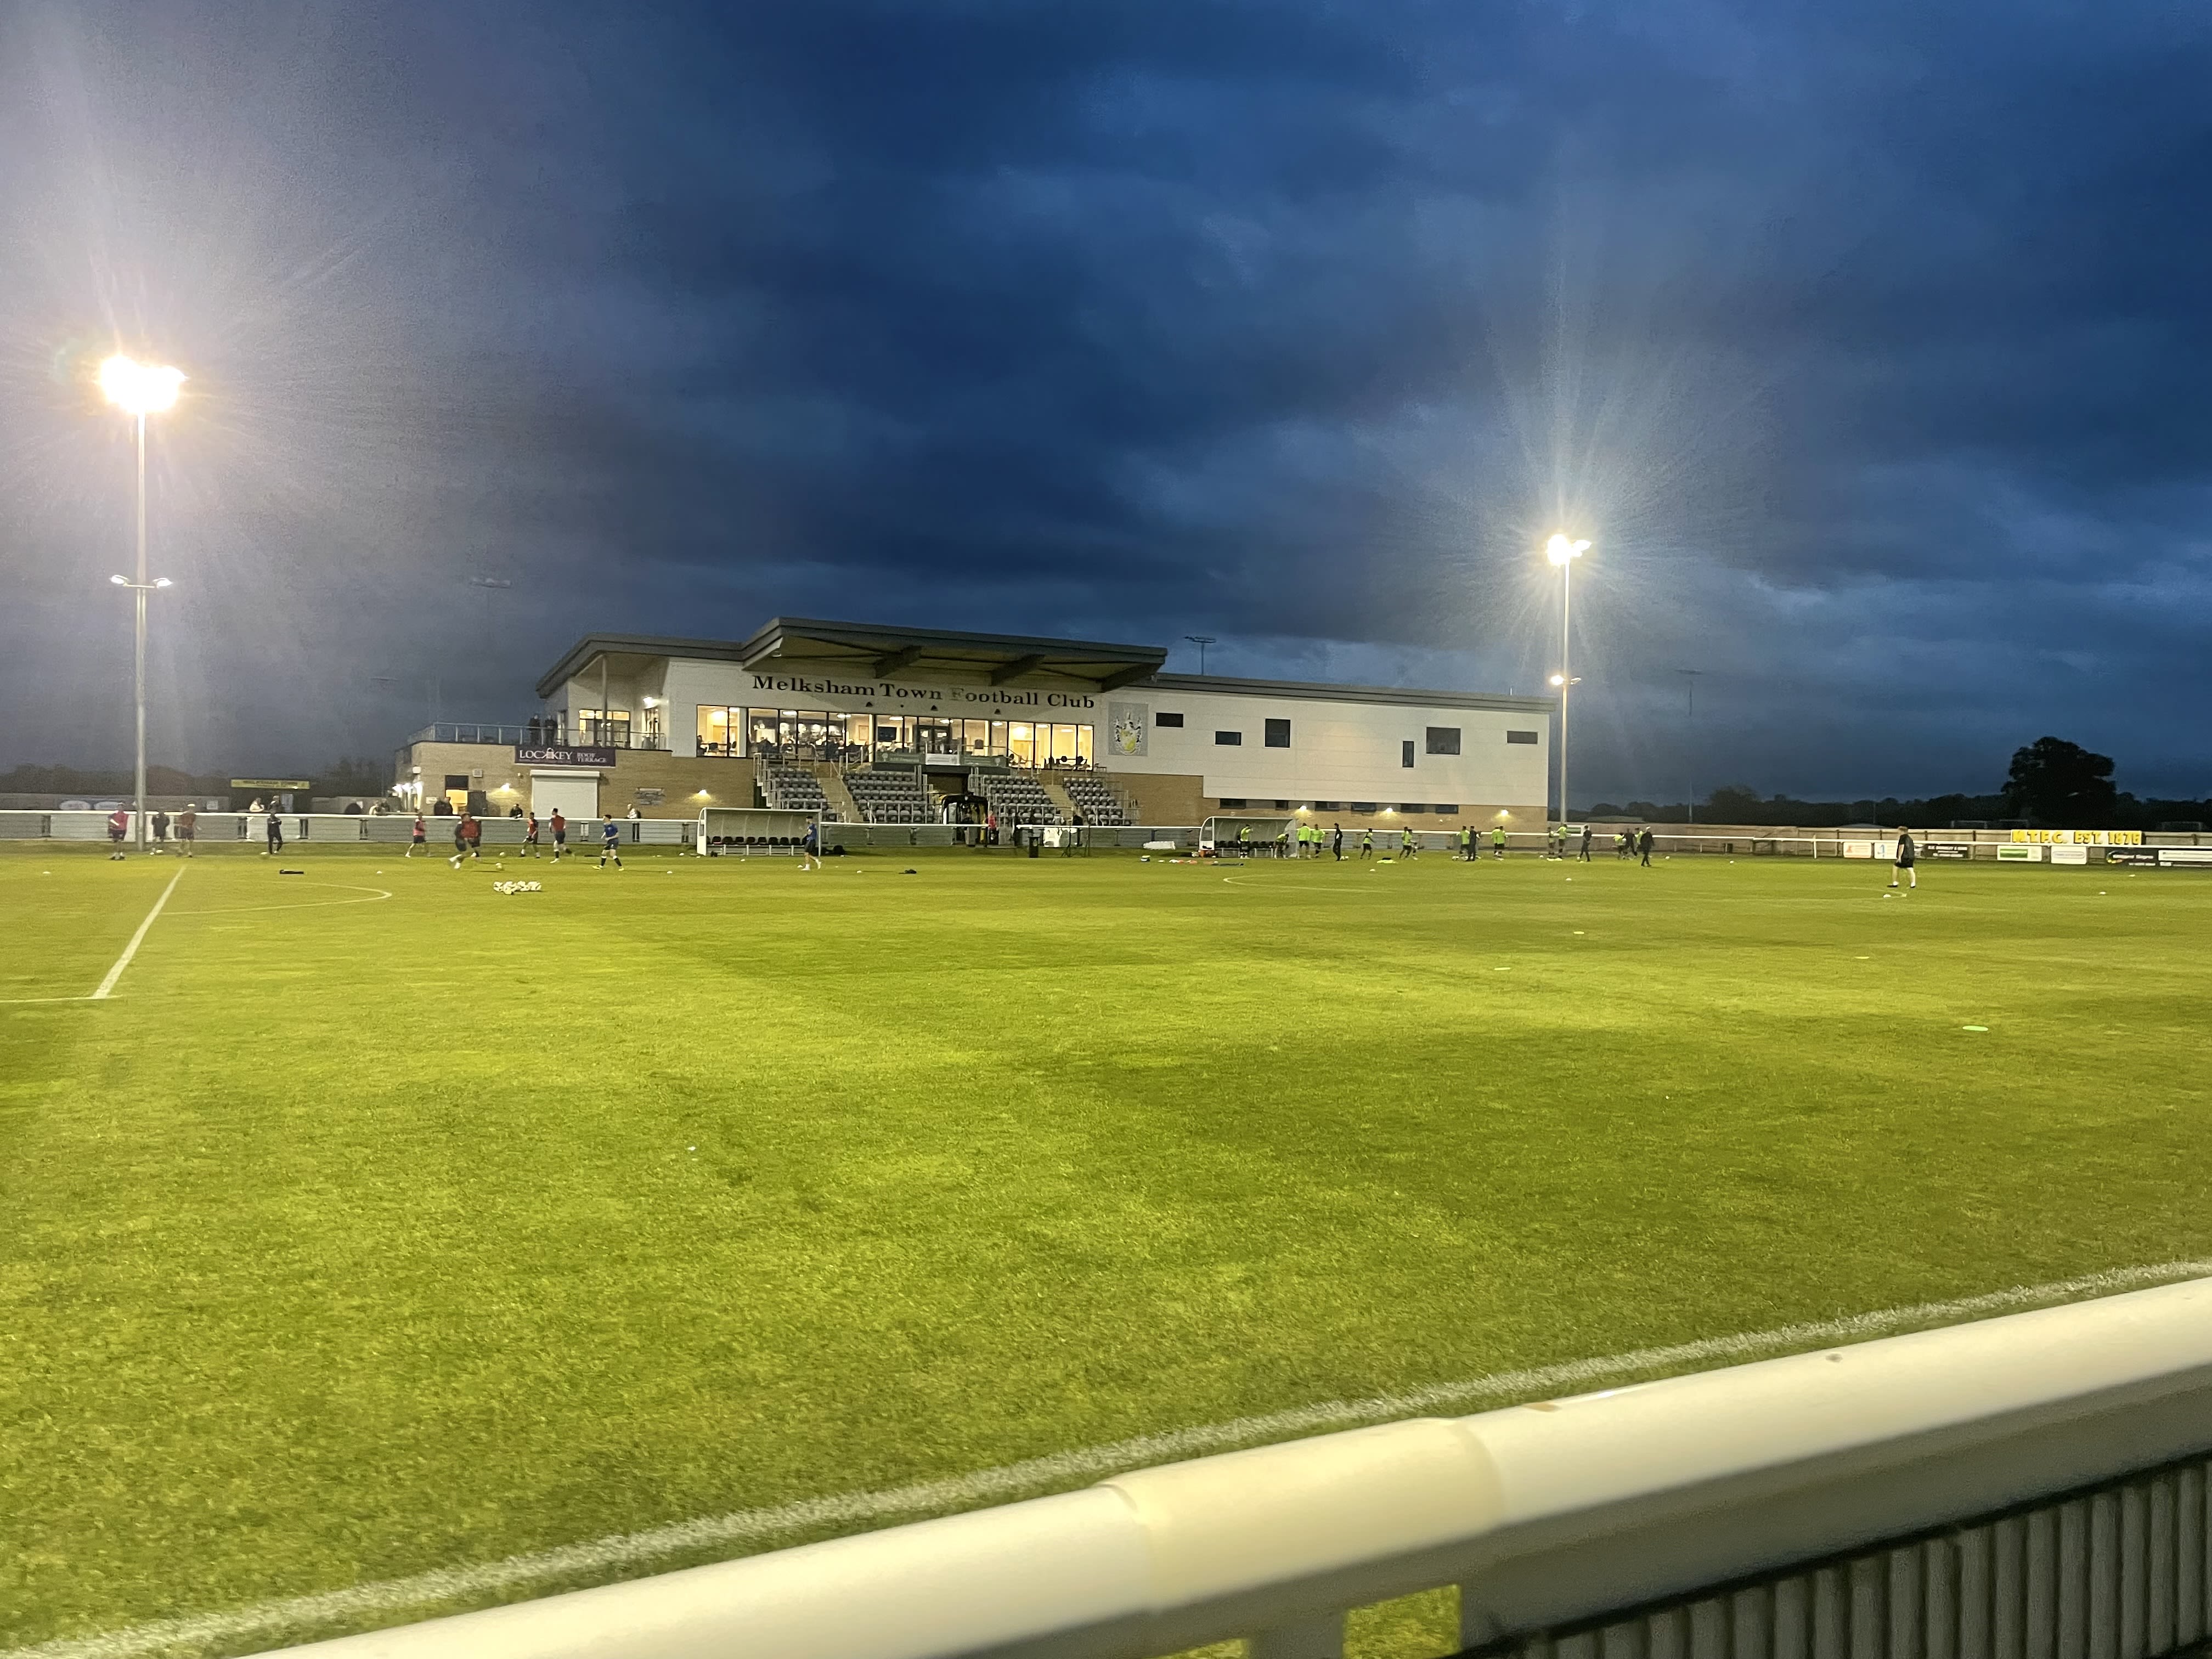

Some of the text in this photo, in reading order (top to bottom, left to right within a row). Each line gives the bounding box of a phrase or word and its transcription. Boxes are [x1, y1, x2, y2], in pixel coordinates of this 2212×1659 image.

[752, 675, 1095, 709] Melksham Town Football Club
